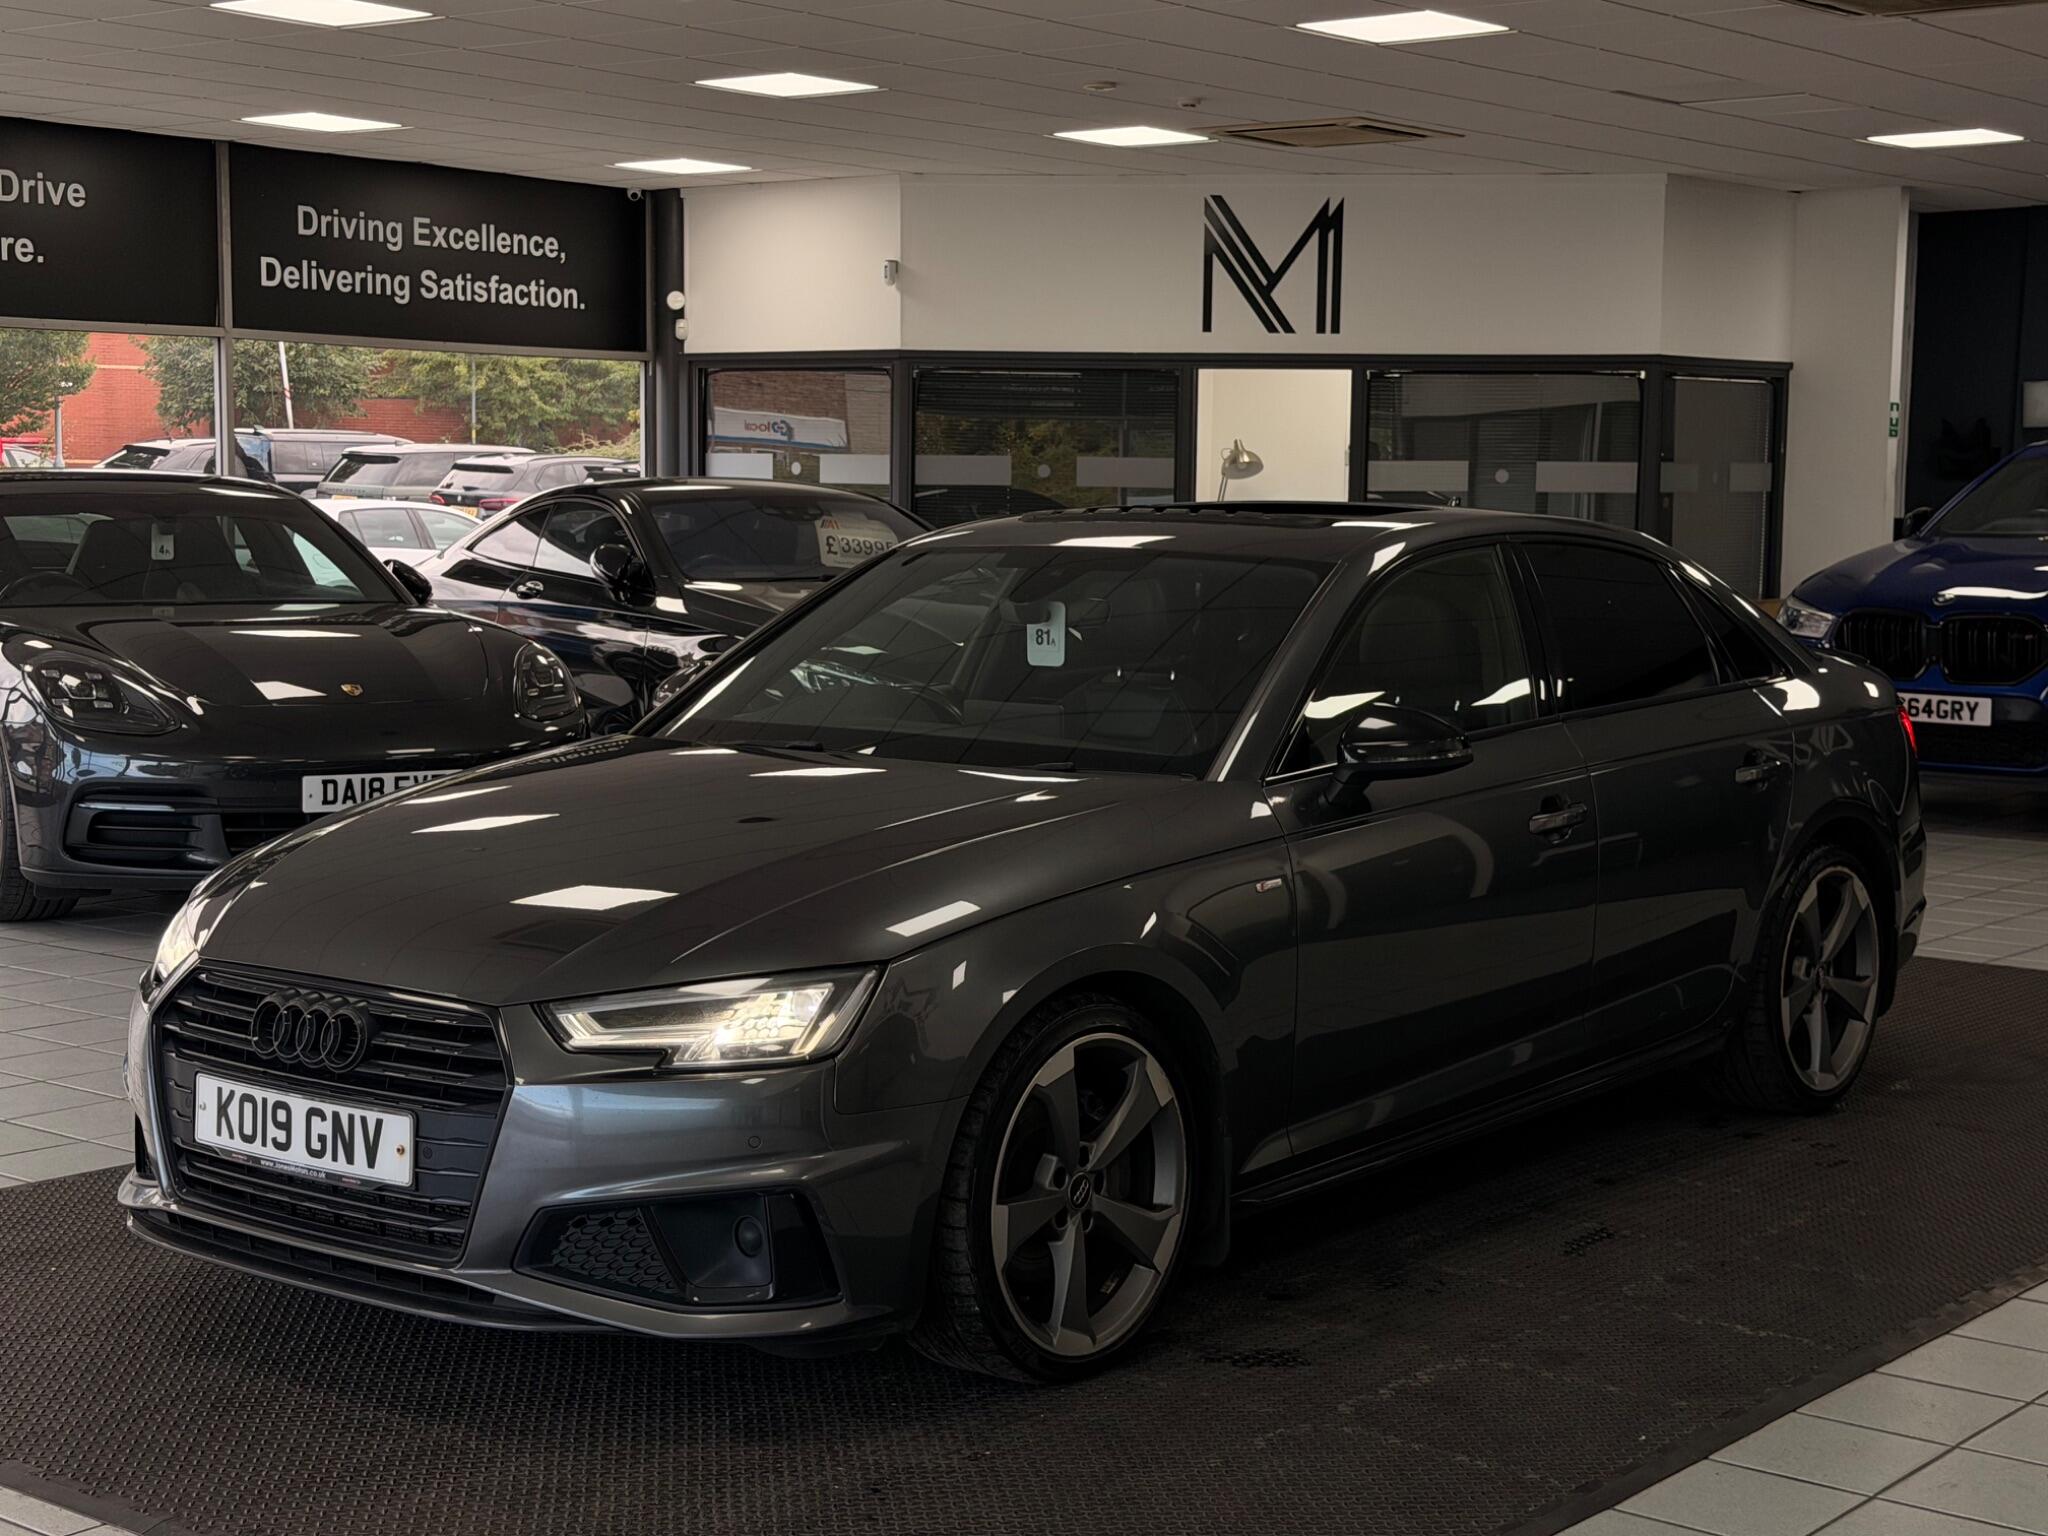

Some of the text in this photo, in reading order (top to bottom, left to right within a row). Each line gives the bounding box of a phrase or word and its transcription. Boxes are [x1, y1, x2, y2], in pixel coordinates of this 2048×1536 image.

[0, 169, 86, 208] Drive
[297, 204, 566, 264] Driving Excellence,
[260, 256, 586, 310] Delivering Satisfaction.
[1897, 697, 1979, 722] 64GRY
[321, 777, 385, 806] DA18
[216, 1086, 383, 1169] KO19 GNV
